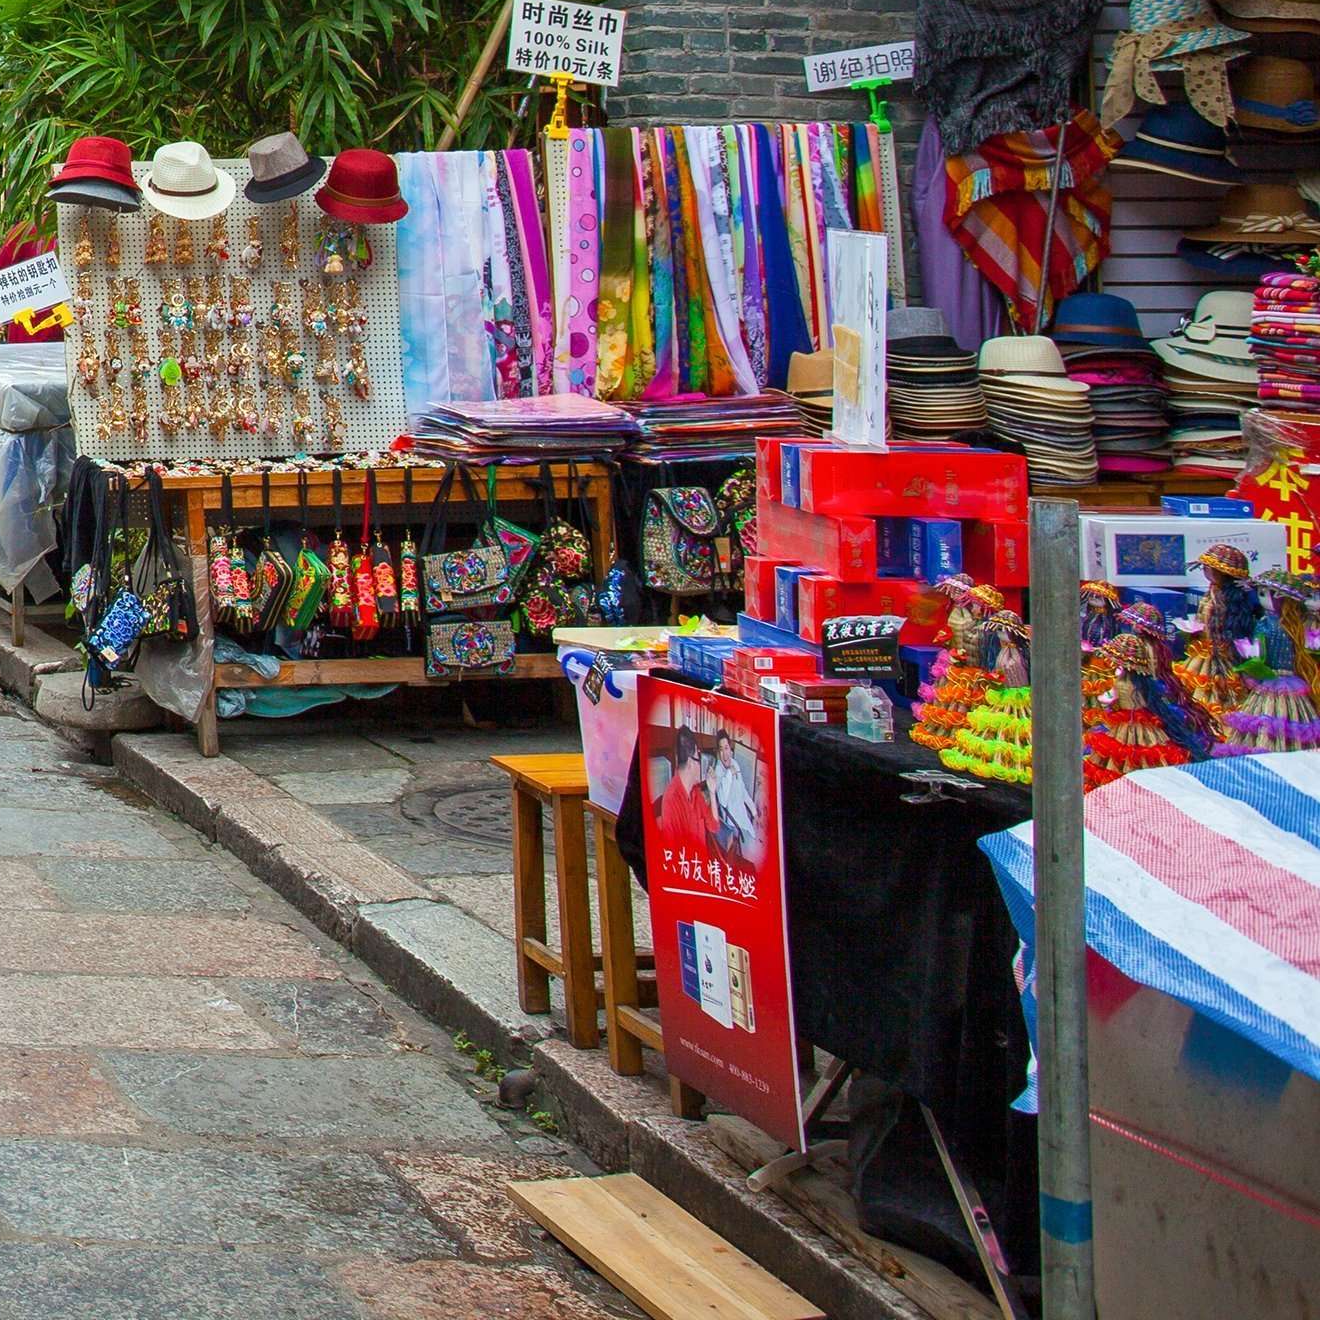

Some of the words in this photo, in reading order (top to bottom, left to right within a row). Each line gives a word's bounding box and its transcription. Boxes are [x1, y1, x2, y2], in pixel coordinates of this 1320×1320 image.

[521, 0, 618, 36] 时尚丝巾
[523, 29, 571, 50] 100%
[575, 36, 610, 57] Silk
[514, 47, 615, 80] 特价10元/条
[812, 47, 915, 84] 谢绝拍照
